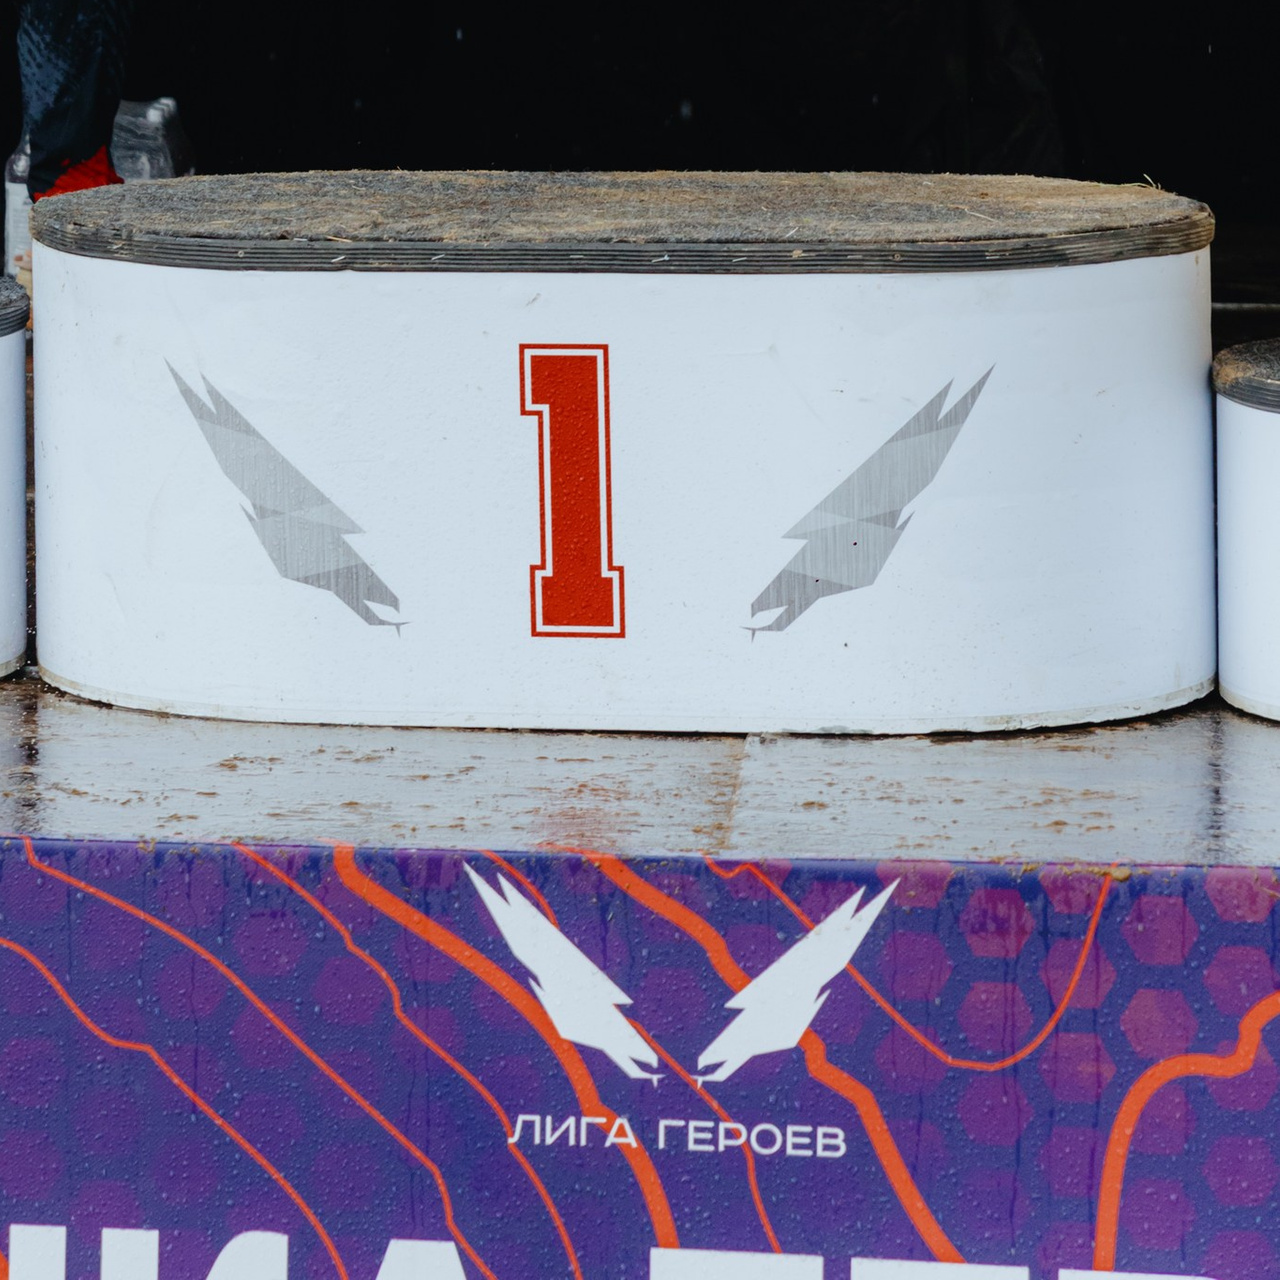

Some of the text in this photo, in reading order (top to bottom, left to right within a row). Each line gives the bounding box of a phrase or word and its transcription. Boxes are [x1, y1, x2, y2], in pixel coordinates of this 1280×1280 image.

[518, 343, 626, 638] 1
[507, 1113, 847, 1159] ЛИГА ГЕРОЕВ
